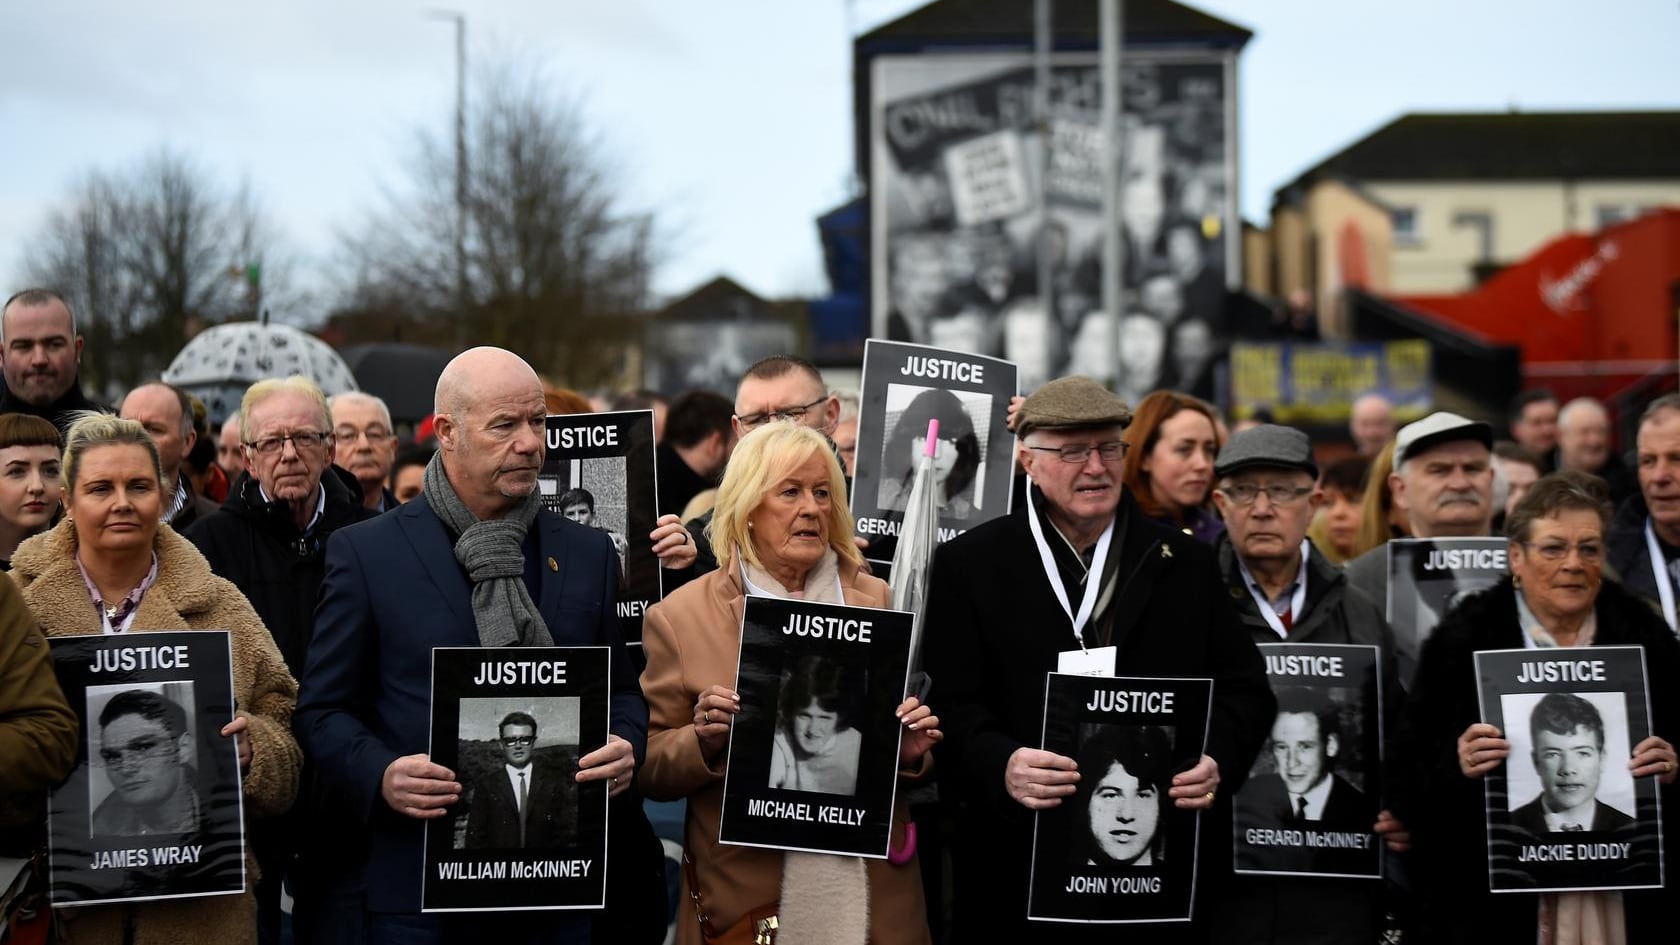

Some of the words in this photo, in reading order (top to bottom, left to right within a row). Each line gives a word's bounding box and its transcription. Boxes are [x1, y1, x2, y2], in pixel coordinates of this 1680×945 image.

[901, 355, 984, 384] JUSTICE
[546, 425, 619, 450] USTICE
[856, 517, 901, 537] GERAL
[1424, 549, 1507, 570] JUSTICE
[783, 613, 873, 643] JUSTICE
[89, 645, 190, 673] JUSTICE
[1265, 655, 1344, 677] JUSTICE
[474, 661, 567, 685] JUSTICE
[1516, 660, 1606, 683] JUSTICE
[1086, 690, 1175, 714] JUSTICE
[748, 798, 814, 823] MICHAEL
[818, 805, 866, 827] KELLY
[1245, 828, 1302, 848] GERARD
[1305, 830, 1371, 849] McKINNEY
[90, 848, 149, 870] JAMES
[151, 844, 203, 867] WRAY
[1518, 844, 1573, 863] JACKIE
[1577, 842, 1631, 861] DUDDY
[438, 861, 508, 880] WILLIAM
[510, 859, 592, 879] McKINNEY
[1065, 875, 1108, 894] JOHN
[1111, 876, 1161, 894] YOUNG
